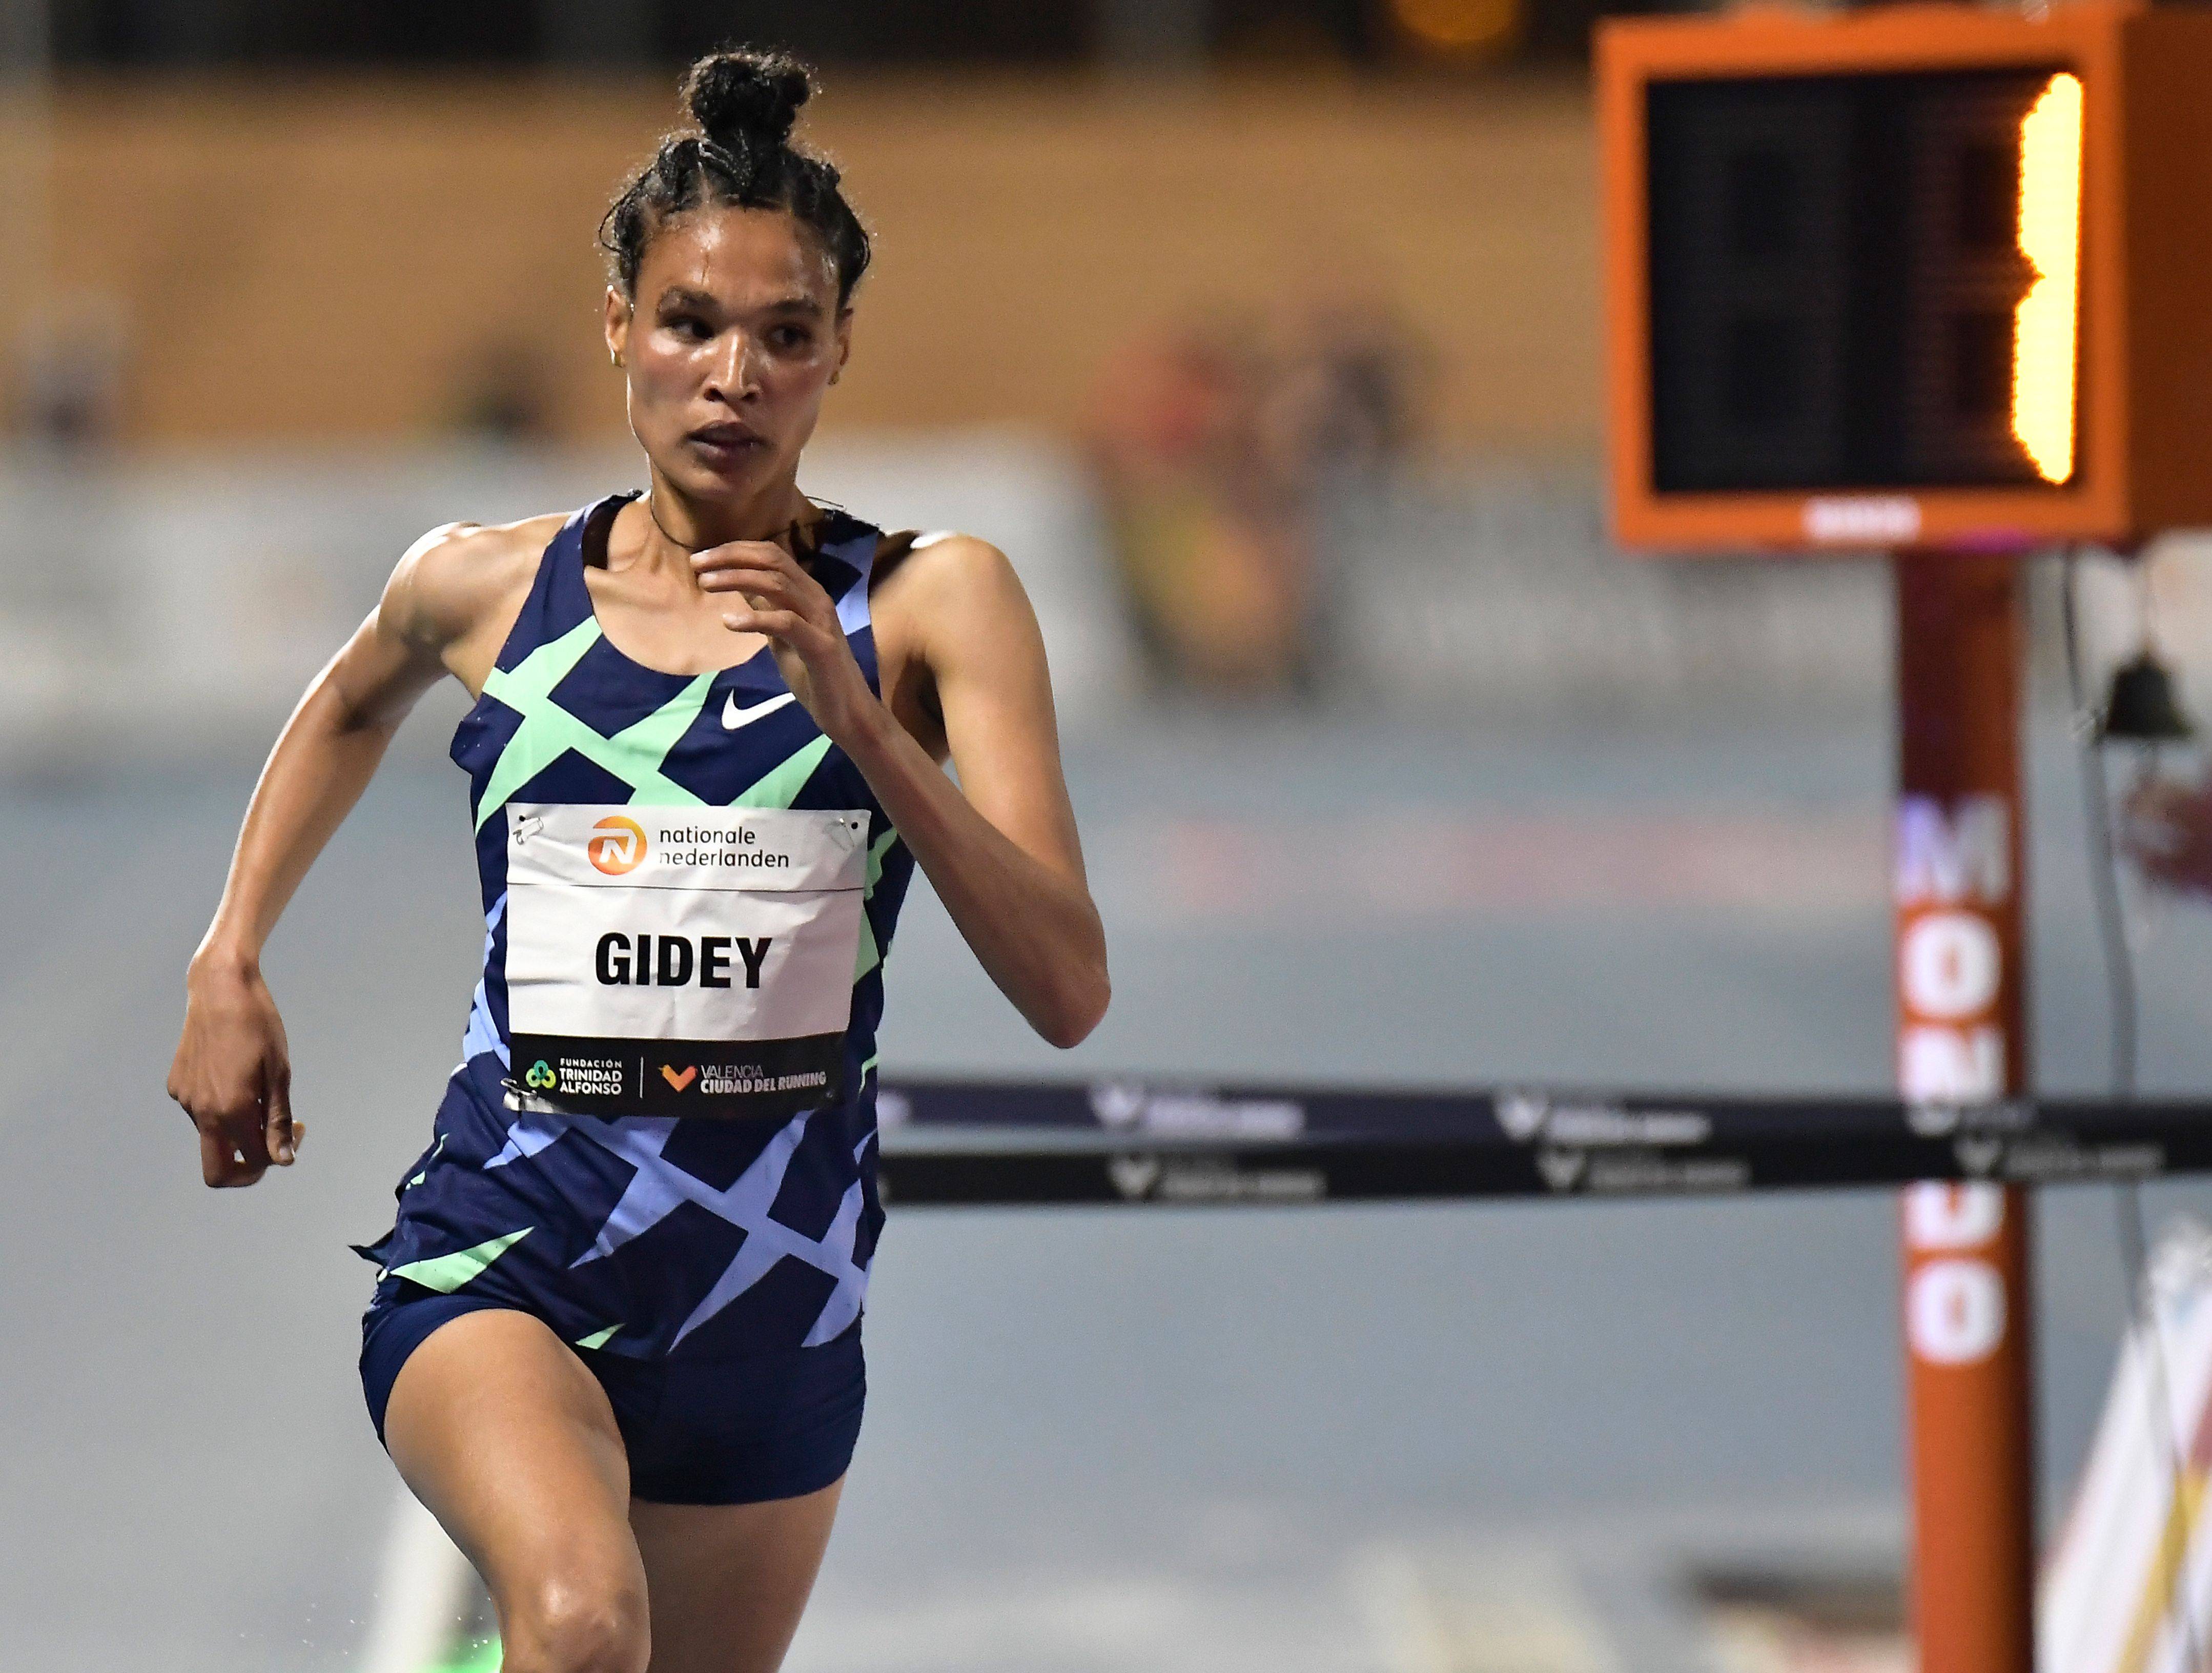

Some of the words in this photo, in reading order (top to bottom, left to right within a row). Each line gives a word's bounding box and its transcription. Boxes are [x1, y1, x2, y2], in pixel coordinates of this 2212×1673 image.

[2012, 73, 2083, 484] 1
[660, 826, 755, 844] nationale
[660, 848, 789, 867] nederlanden
[595, 932, 772, 989] GIDEY
[560, 1057, 622, 1068] FUNDACIÓN
[559, 1068, 622, 1082] TRINIDAD
[701, 1065, 764, 1078] VALENCIA
[559, 1081, 622, 1095] ALFONSO
[700, 1079, 752, 1094] CIUDAD
[754, 1078, 776, 1092] DEL
